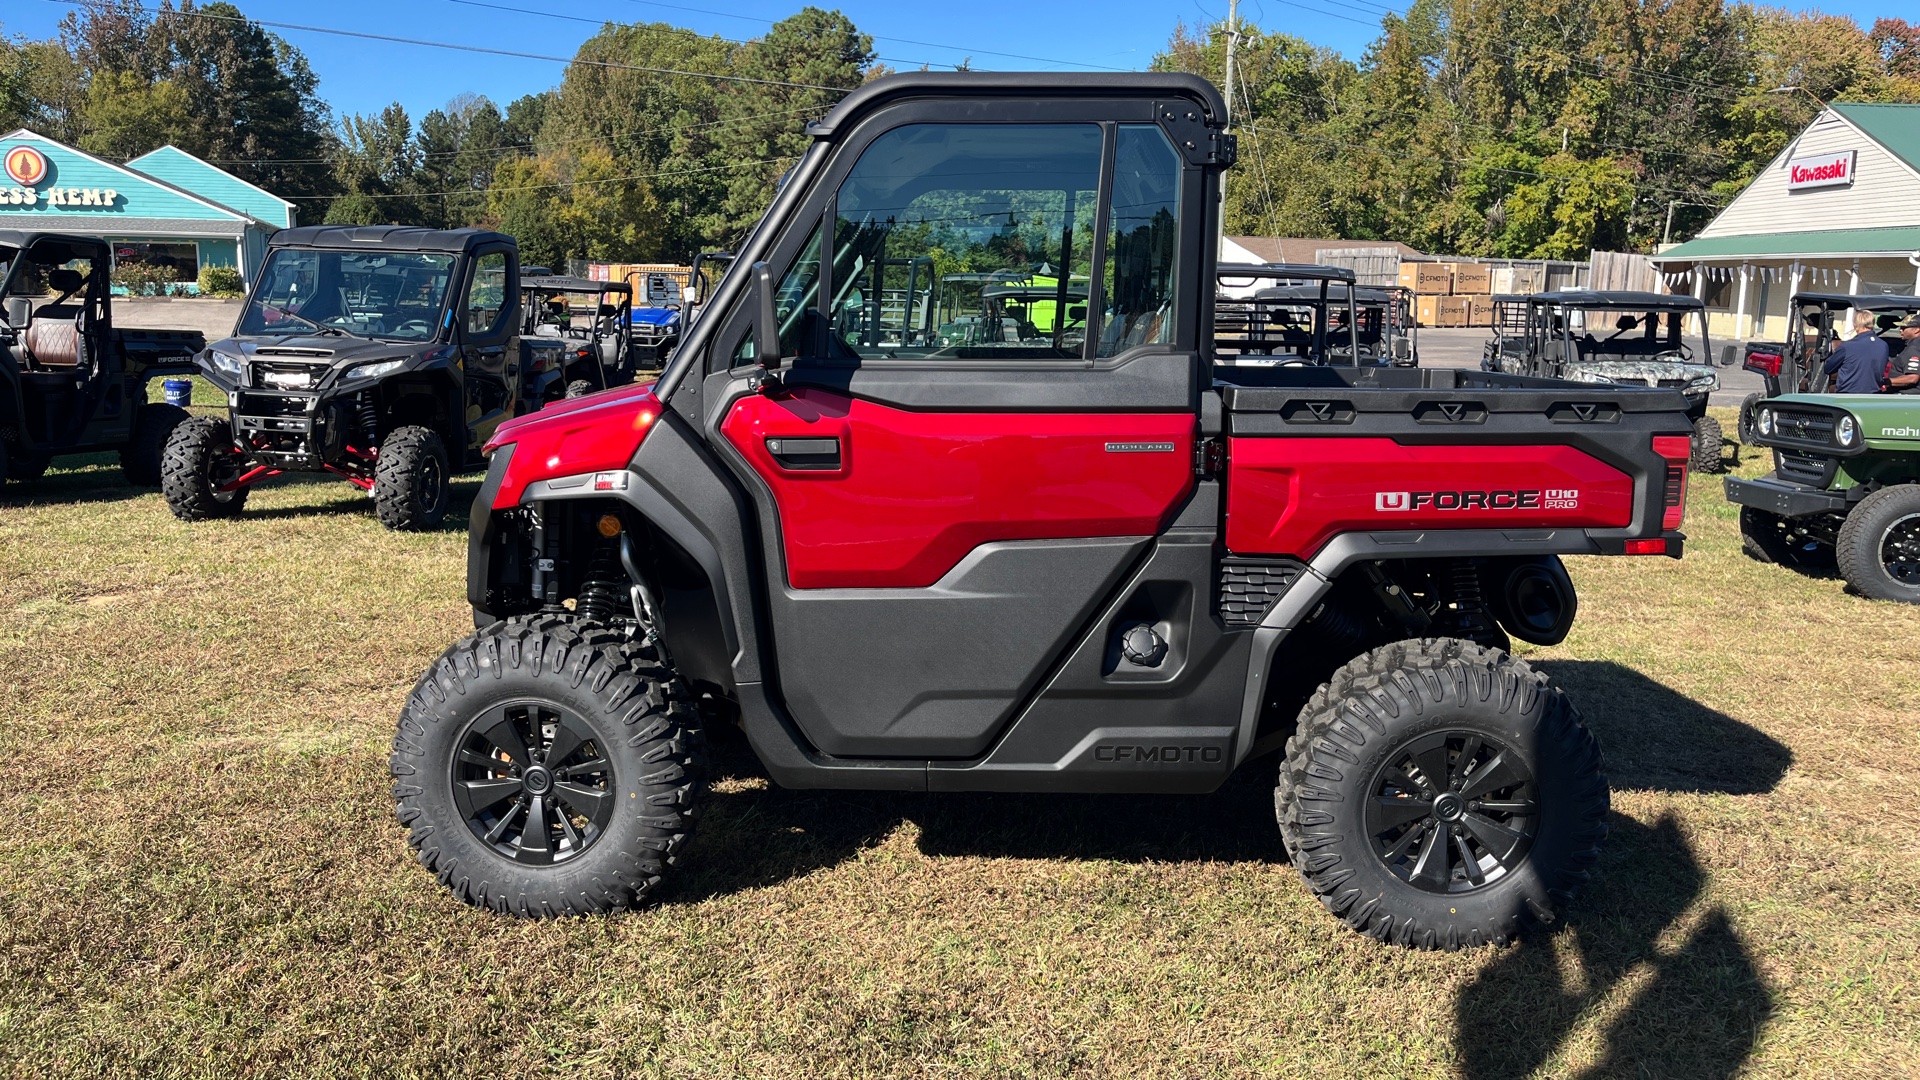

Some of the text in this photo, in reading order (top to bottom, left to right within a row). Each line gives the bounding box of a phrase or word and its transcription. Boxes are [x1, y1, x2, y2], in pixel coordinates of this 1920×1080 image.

[1790, 158, 1848, 183] Kawasaki
[47, 187, 118, 206] HEMP
[1545, 500, 1578, 509] PRO
[1094, 745, 1222, 763] CFMOTO
